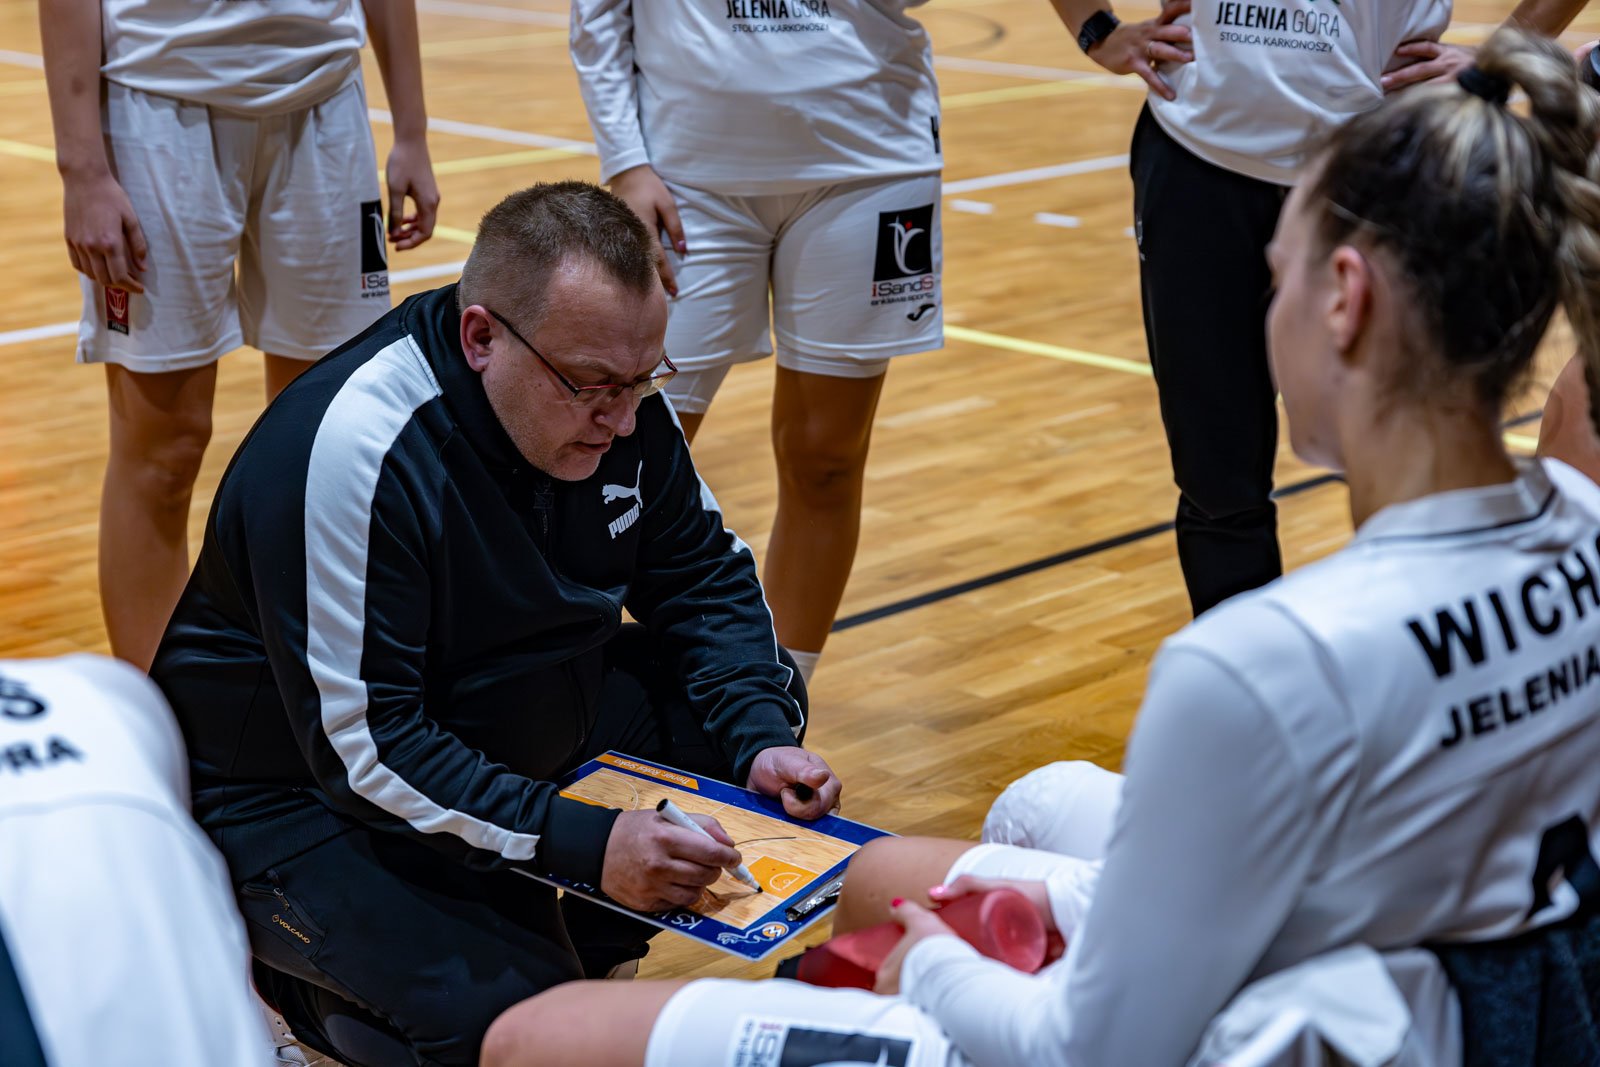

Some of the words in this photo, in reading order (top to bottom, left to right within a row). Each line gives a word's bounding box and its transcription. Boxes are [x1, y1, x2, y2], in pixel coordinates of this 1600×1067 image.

[726, 0, 789, 18] JELENIA
[1216, 1, 1288, 31] JELENIA
[1292, 9, 1340, 37] GÓRA
[732, 23, 768, 33] STOLICA
[1220, 31, 1261, 45] STOLICA
[1263, 37, 1334, 52] KARKONOSZY
[608, 503, 640, 539] PUMA
[1407, 533, 1600, 678] WICH
[1441, 645, 1600, 748] JELENIA
[0, 739, 84, 774] RA
[280, 919, 311, 944] VOLCANO
